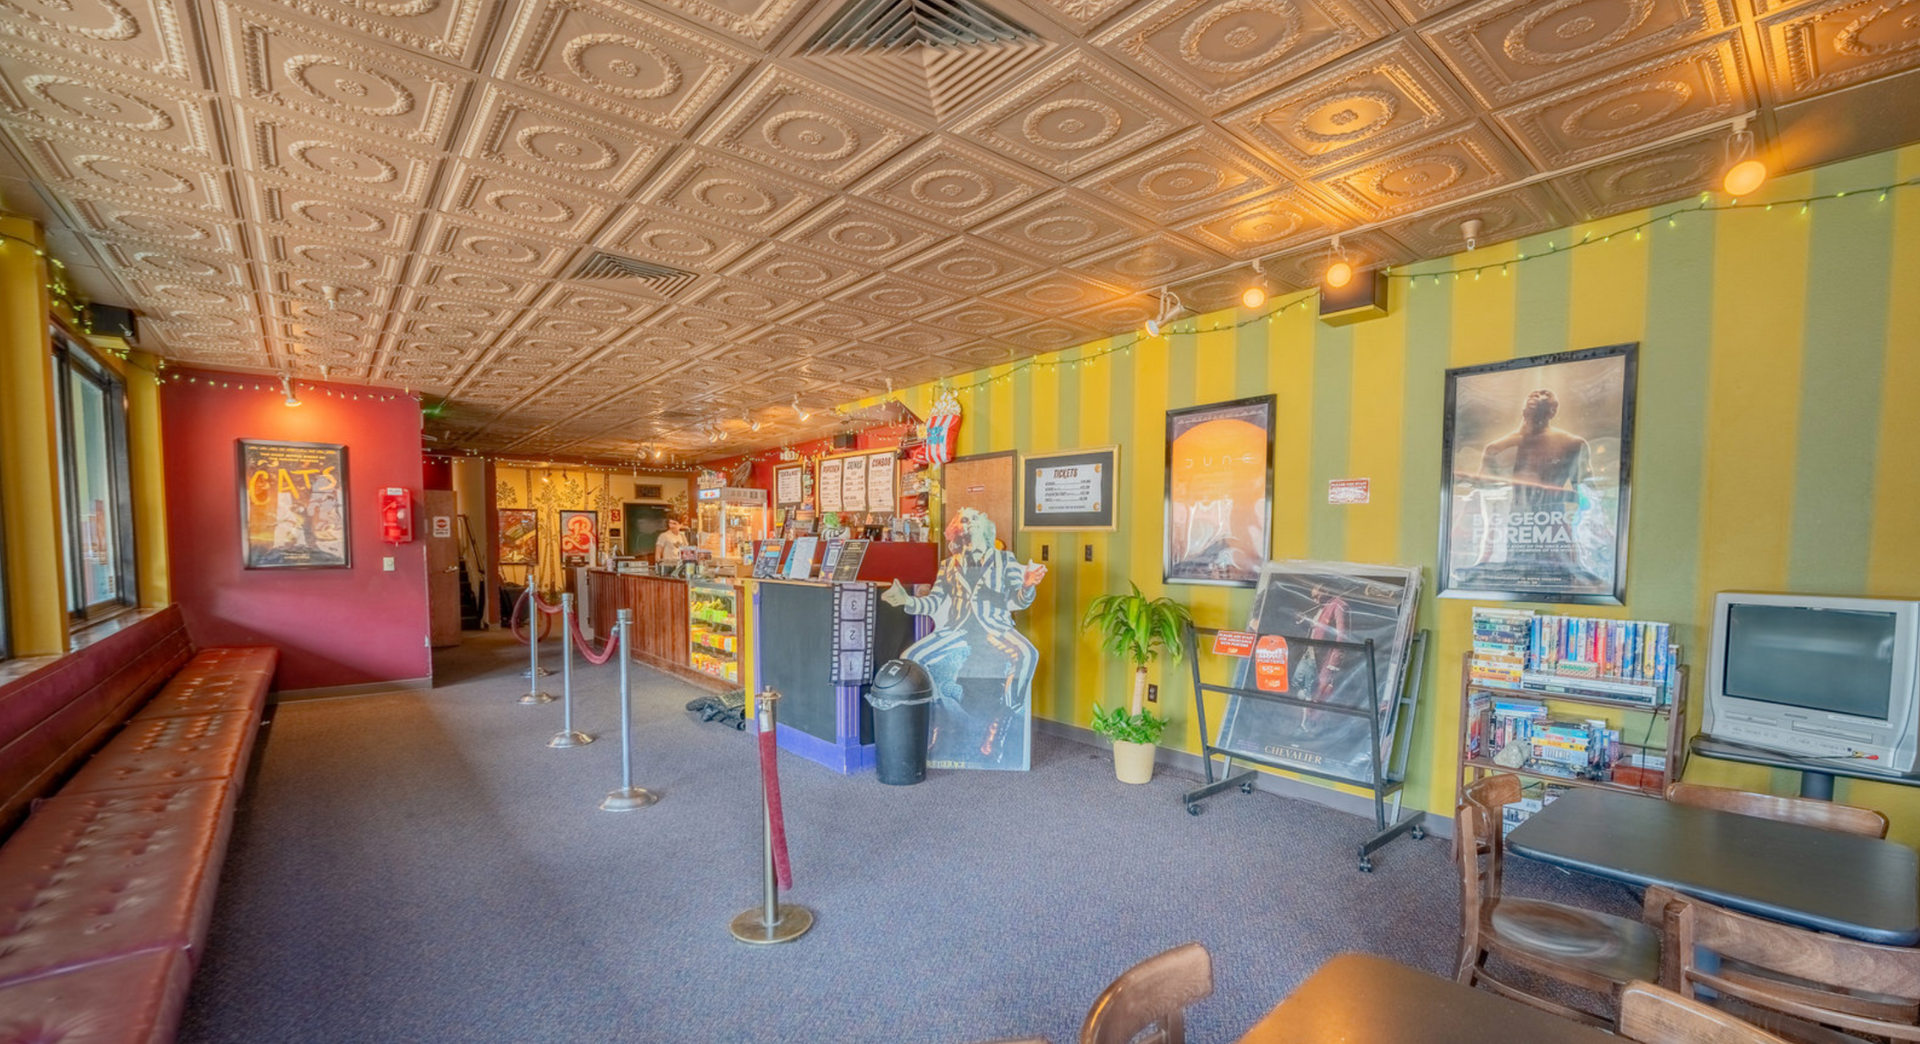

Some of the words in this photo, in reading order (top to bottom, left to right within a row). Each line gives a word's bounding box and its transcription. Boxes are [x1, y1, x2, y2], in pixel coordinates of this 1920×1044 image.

[1053, 468, 1078, 479] TICKETS
[250, 466, 337, 506] CATS
[612, 510, 620, 521] 3
[1472, 513, 1503, 526] BG
[1472, 526, 1580, 544] FOREMA
[850, 600, 858, 611] 3
[849, 630, 856, 641] 2
[1264, 744, 1322, 766] CHEVALIER
